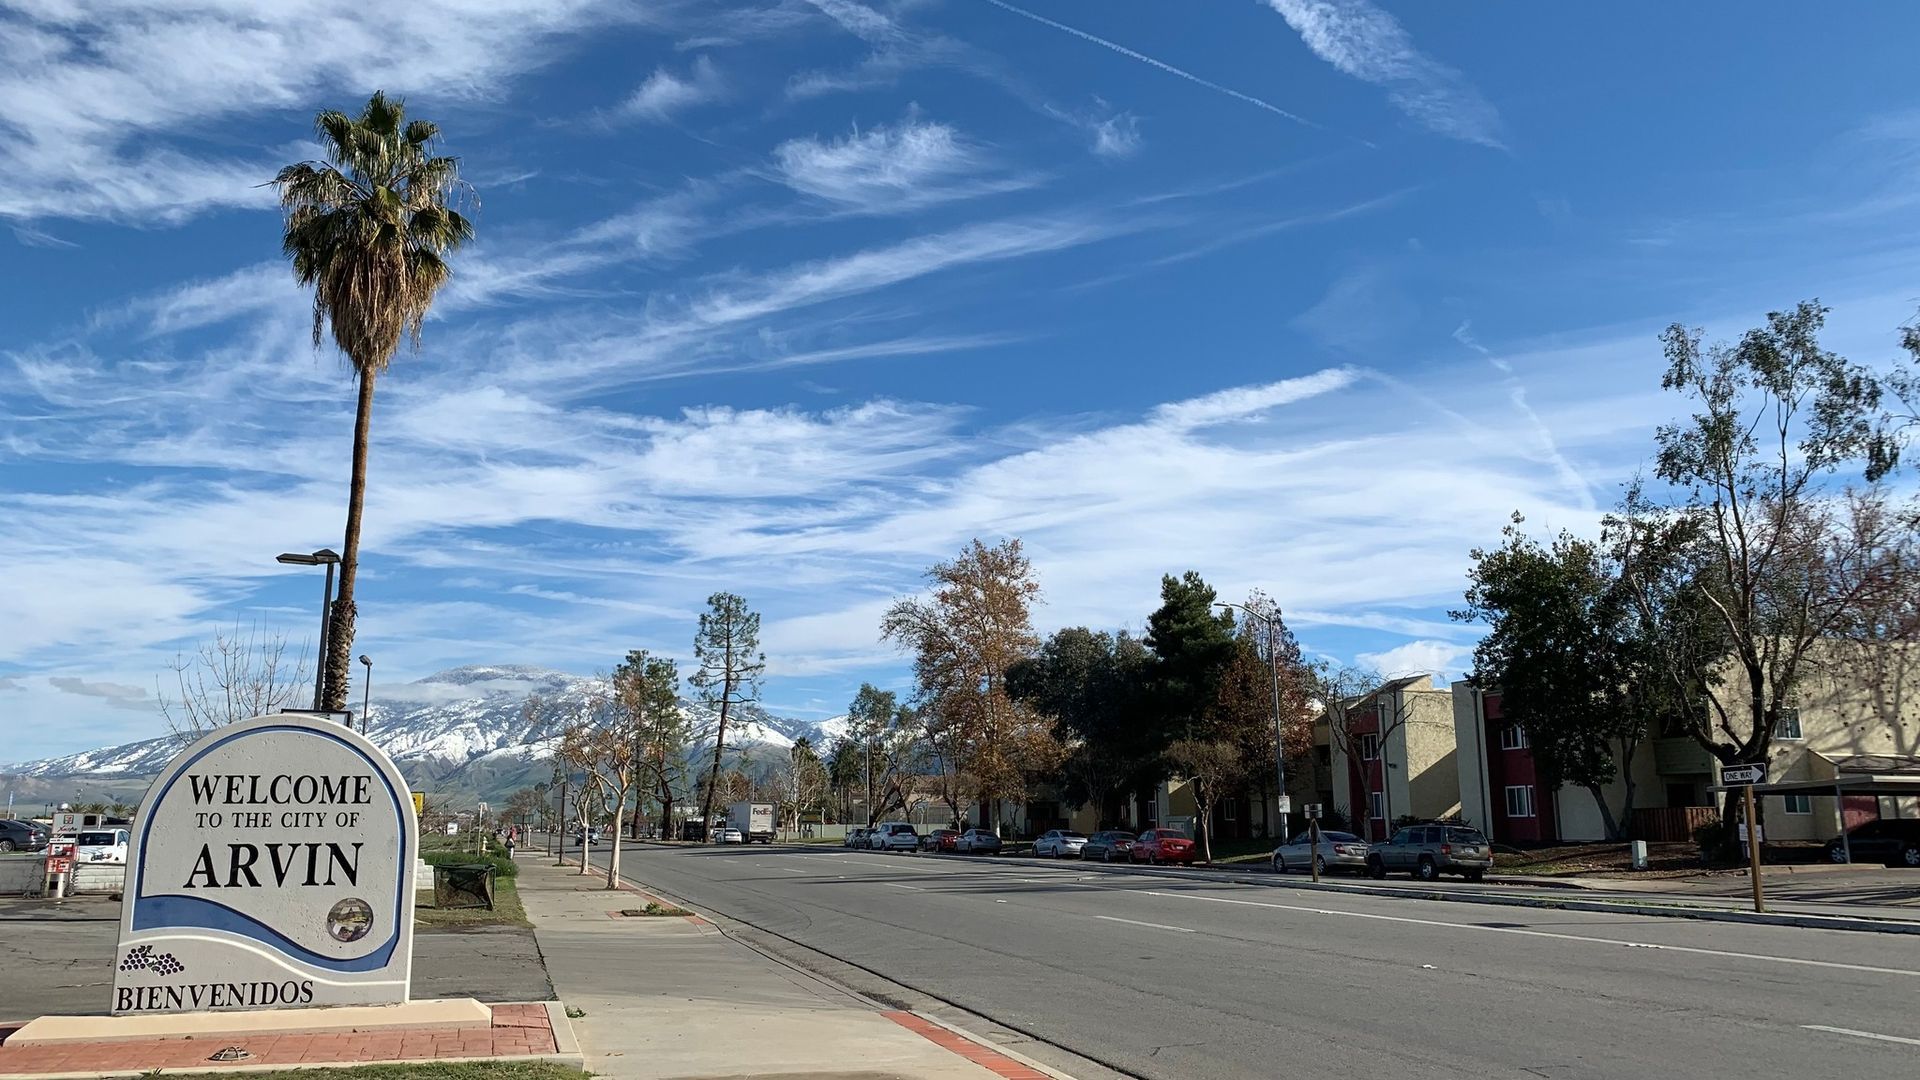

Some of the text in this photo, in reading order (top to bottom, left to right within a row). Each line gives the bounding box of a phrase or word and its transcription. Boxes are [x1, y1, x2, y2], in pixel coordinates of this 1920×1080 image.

[1725, 771, 1753, 780] ONE WAY
[188, 775, 372, 805] WELCOME
[195, 811, 360, 828] TO THE CITY OF
[752, 807, 773, 816] FedEx
[183, 842, 364, 889] ARVIN
[115, 980, 314, 1012] BIENVENIDOS
